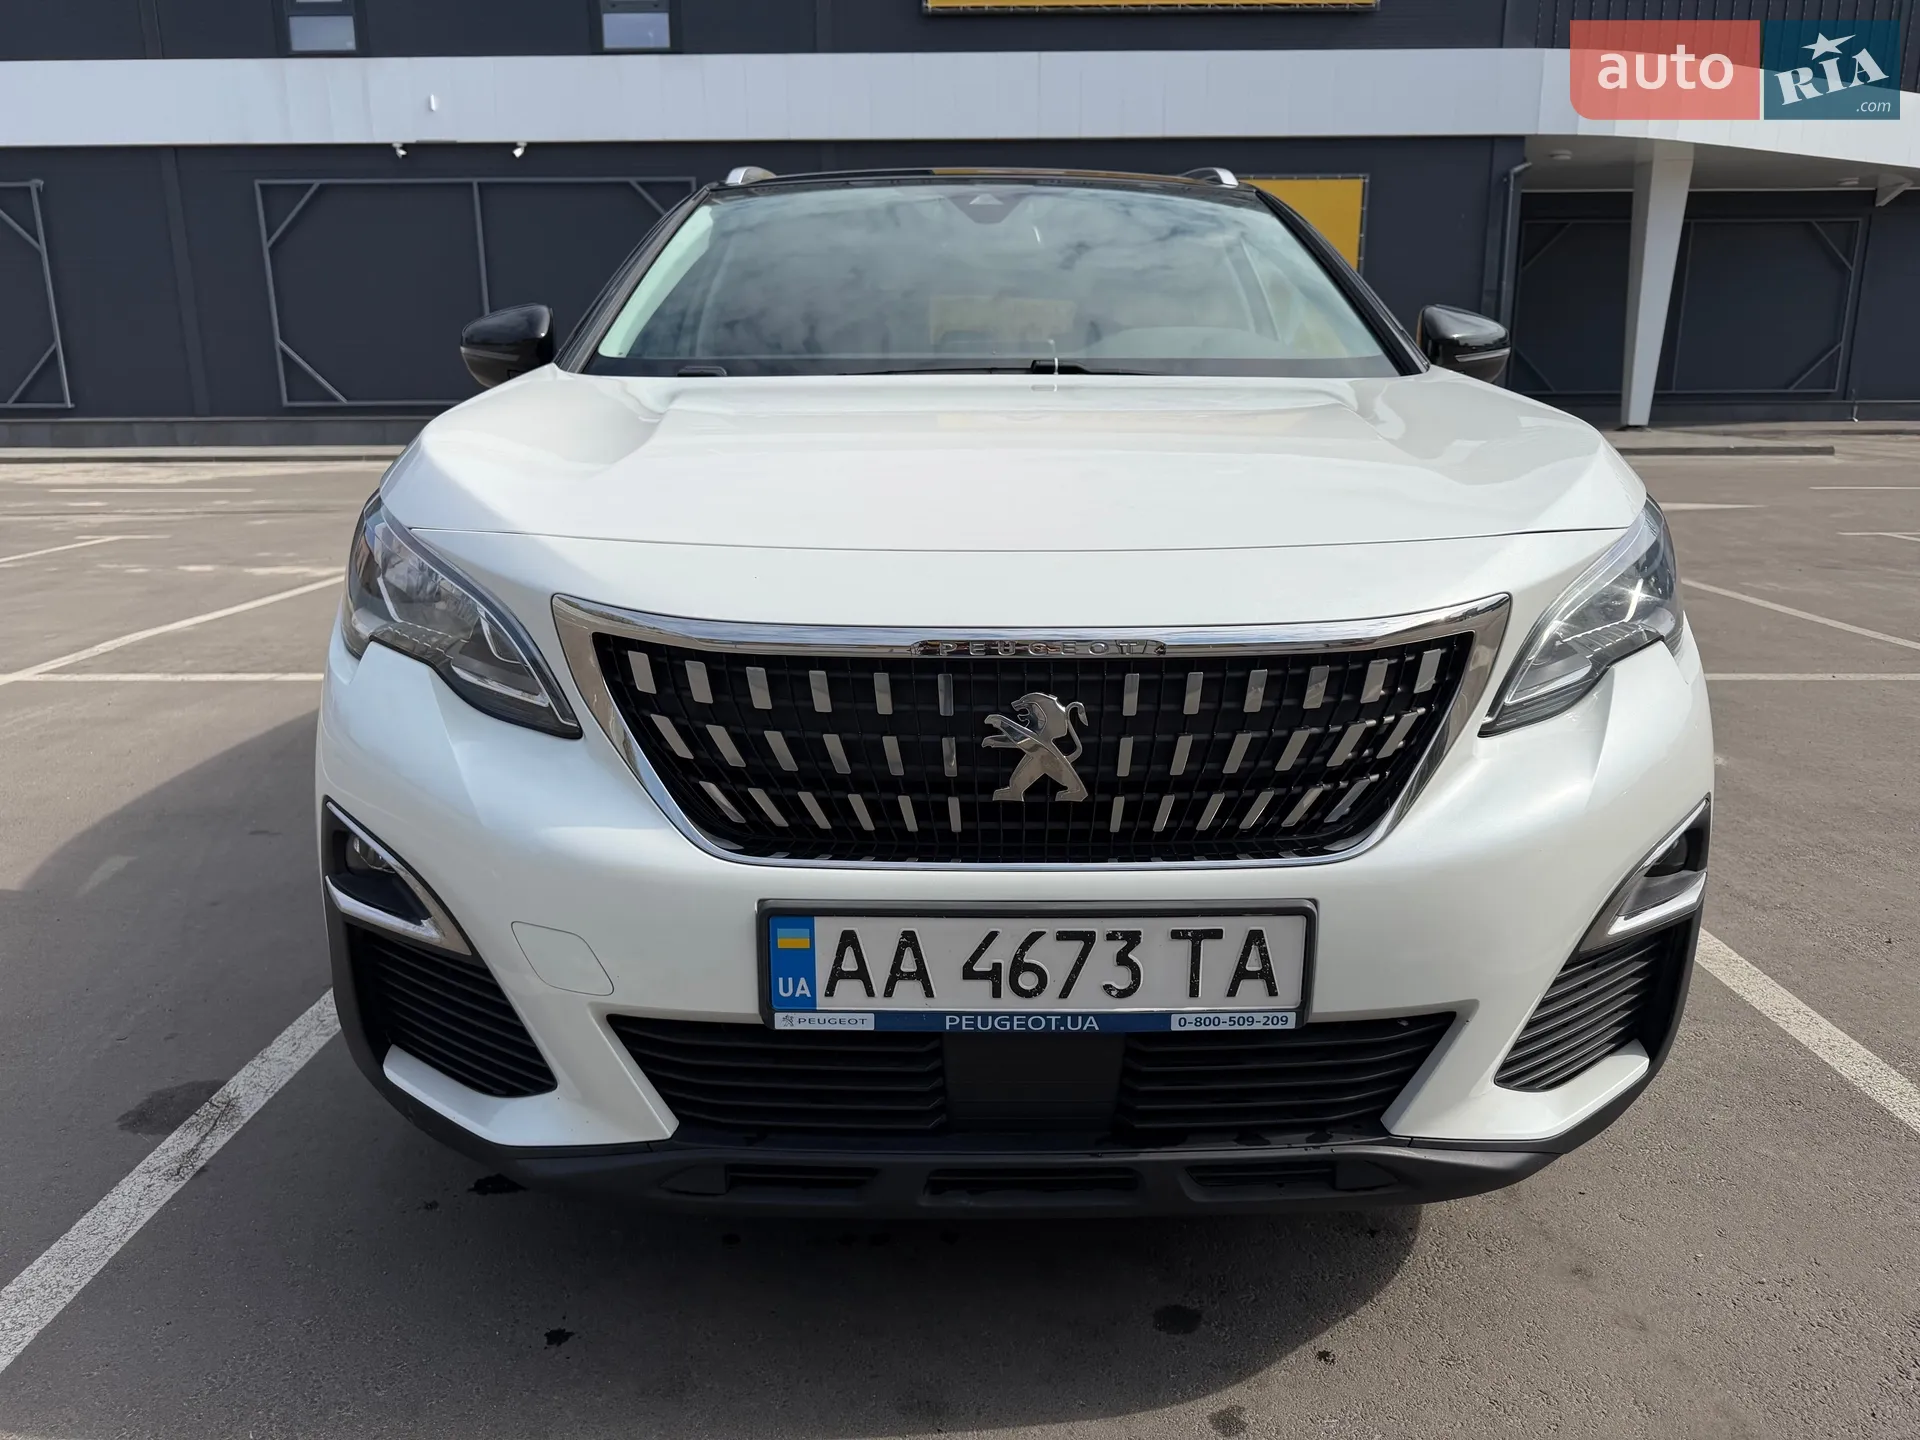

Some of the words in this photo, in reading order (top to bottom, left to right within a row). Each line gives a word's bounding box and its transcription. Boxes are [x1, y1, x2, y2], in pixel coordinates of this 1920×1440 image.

[938, 641, 1138, 656] PEUGEOT
[823, 929, 937, 998] AA
[962, 929, 1143, 999] 4673
[1170, 928, 1280, 998] TA
[778, 977, 811, 998] UA
[797, 1016, 868, 1026] PEUGEOT
[944, 1014, 1100, 1033] PEUGEOT.UA
[1177, 1014, 1290, 1029] 0-800-509-209
